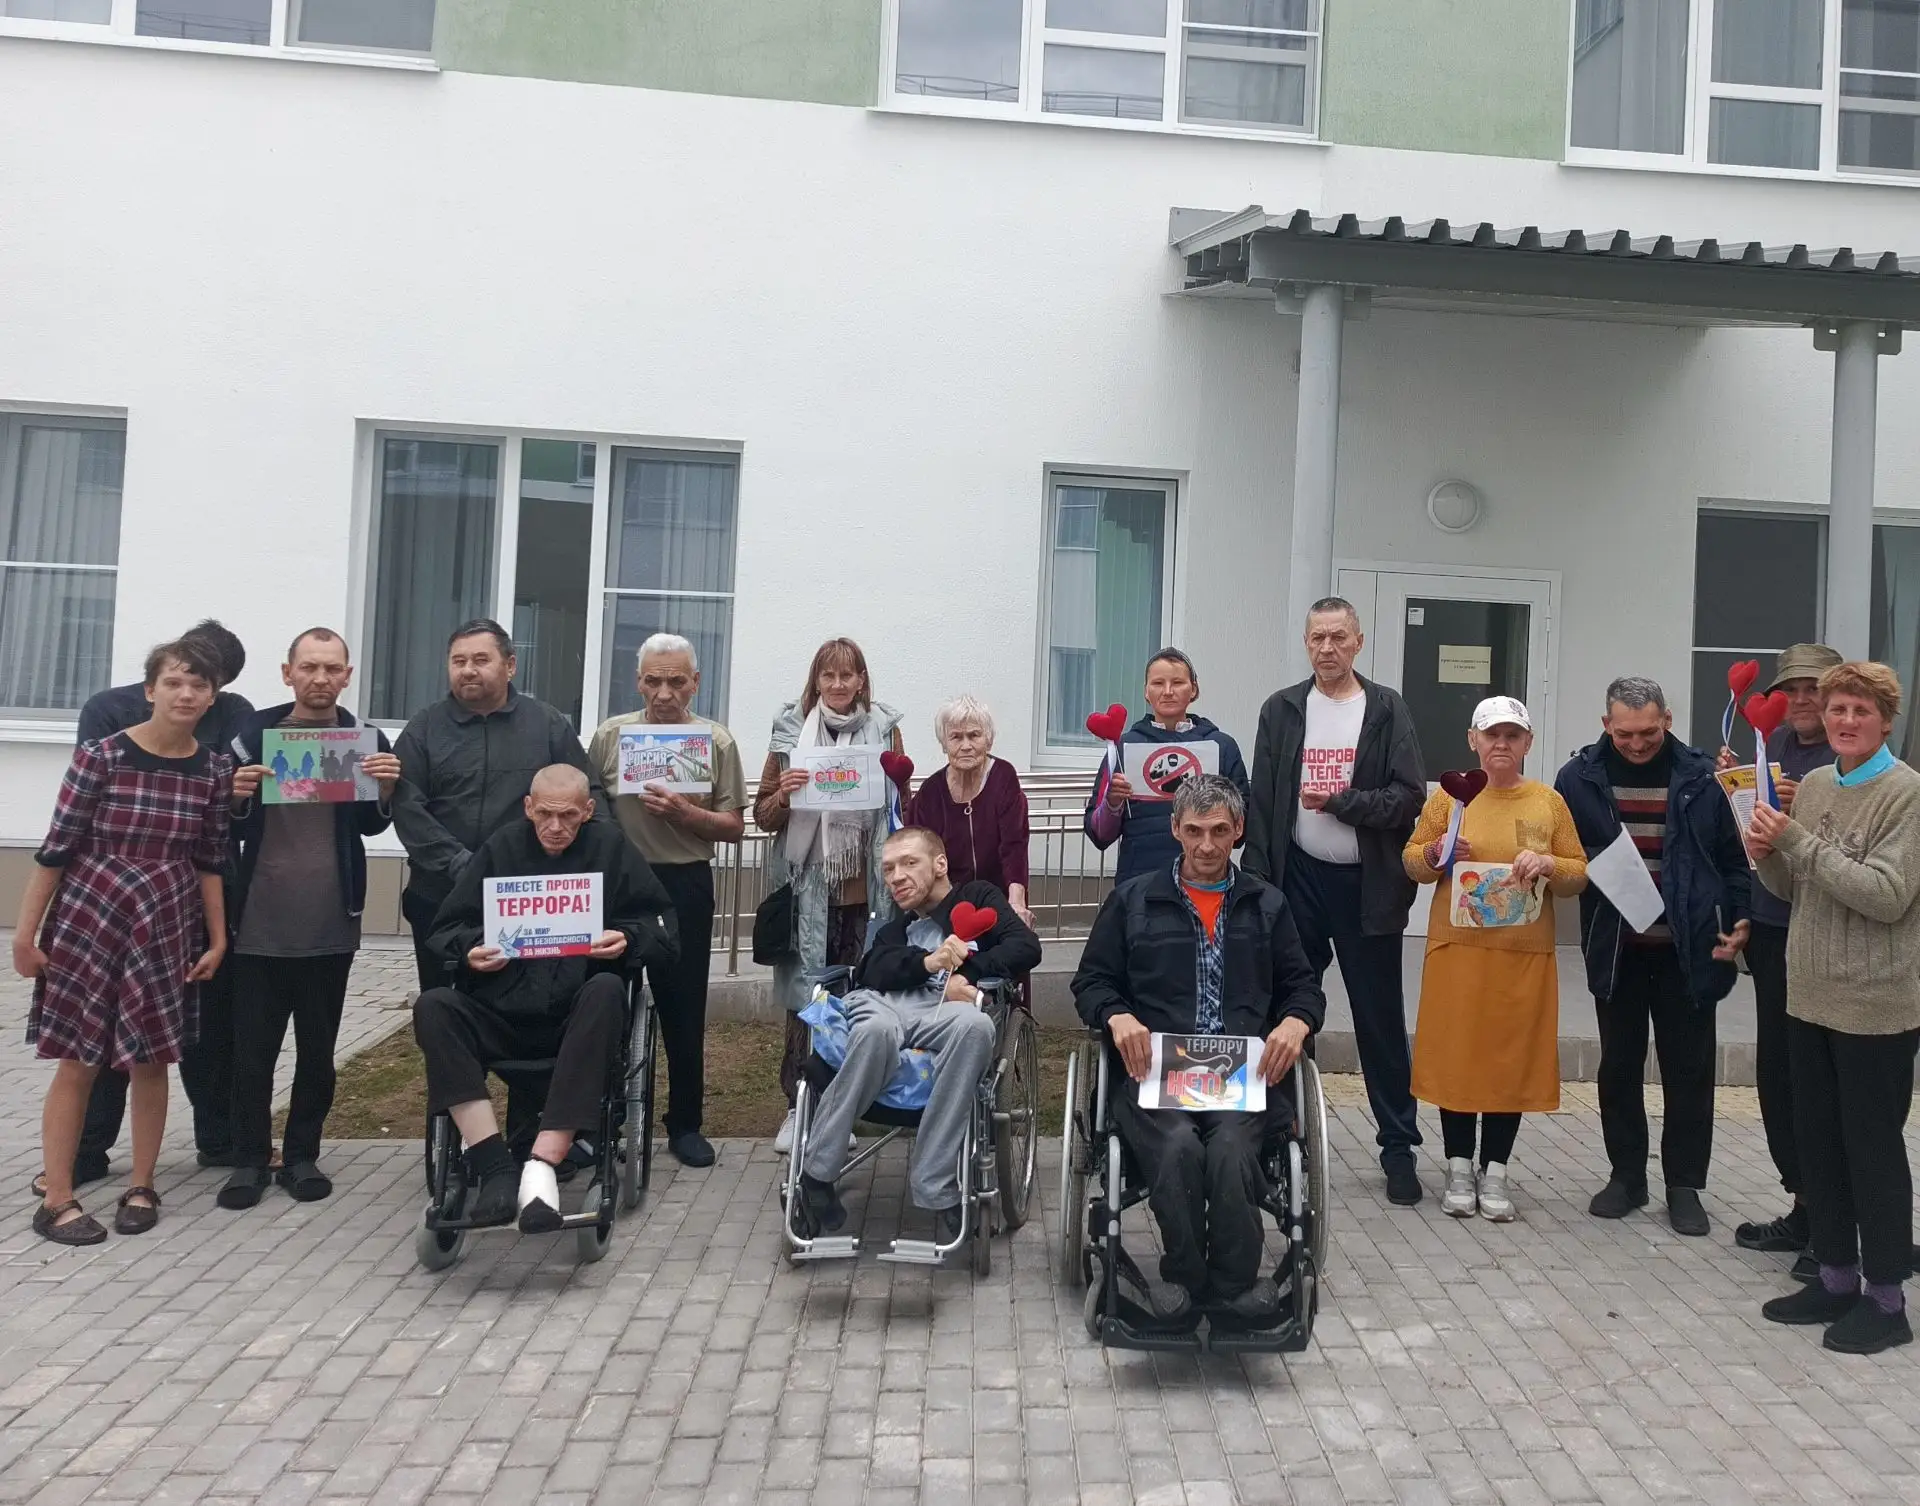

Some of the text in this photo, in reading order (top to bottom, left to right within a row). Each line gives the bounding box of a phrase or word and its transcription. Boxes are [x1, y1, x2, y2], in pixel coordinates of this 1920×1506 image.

[280, 731, 361, 741] ТЕРРОРИЗМУ
[627, 751, 667, 766] РОССИЯ
[1302, 748, 1358, 764] ЗДОРОВ
[628, 762, 655, 774] ПРОТИВ
[1308, 765, 1342, 780] ТЕЛЕ
[497, 878, 591, 894] ВМЕСТЕ ПРОТИВ
[497, 894, 591, 917] ТЕРРОРА!
[524, 927, 551, 936] ЗА МИР
[524, 935, 589, 946] ЗА БЕЗОПАСНОСТЬ
[524, 946, 561, 956] ЗА ЖИЗНЬ
[1185, 1037, 1244, 1055] ТЕРРОРУ
[1167, 1069, 1222, 1098] НЕТ!
